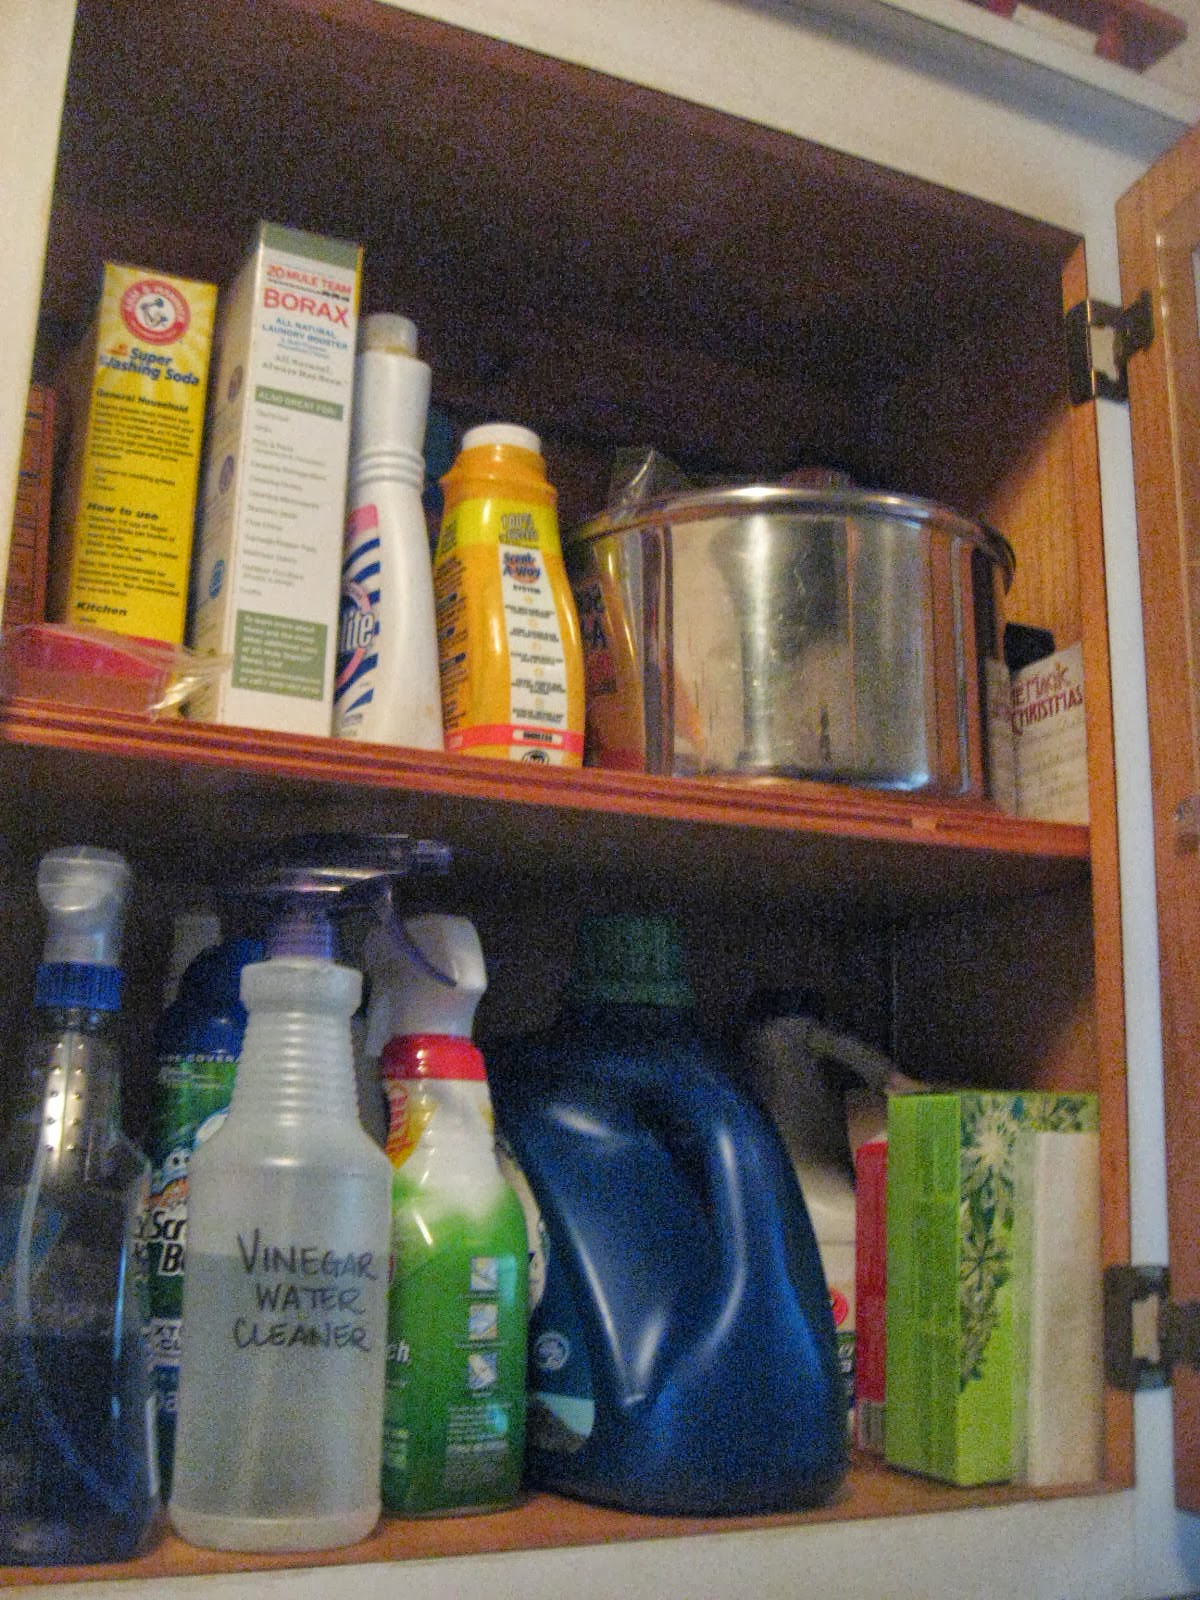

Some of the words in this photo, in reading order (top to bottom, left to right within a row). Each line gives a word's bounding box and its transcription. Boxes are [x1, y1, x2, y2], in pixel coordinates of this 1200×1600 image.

[286, 269, 318, 287] MULE
[321, 275, 353, 294] TEAM
[263, 286, 350, 329] BORAX
[262, 323, 304, 339] LAUNDRY
[130, 346, 172, 366] Super
[164, 367, 200, 386] Soda
[86, 501, 115, 513] How
[119, 506, 132, 516] to
[136, 509, 159, 520] use
[76, 601, 128, 616] Kitchen
[236, 1227, 377, 1281] VINEGAR
[255, 1282, 366, 1316] WATER
[232, 1316, 371, 1352] CLEANER
